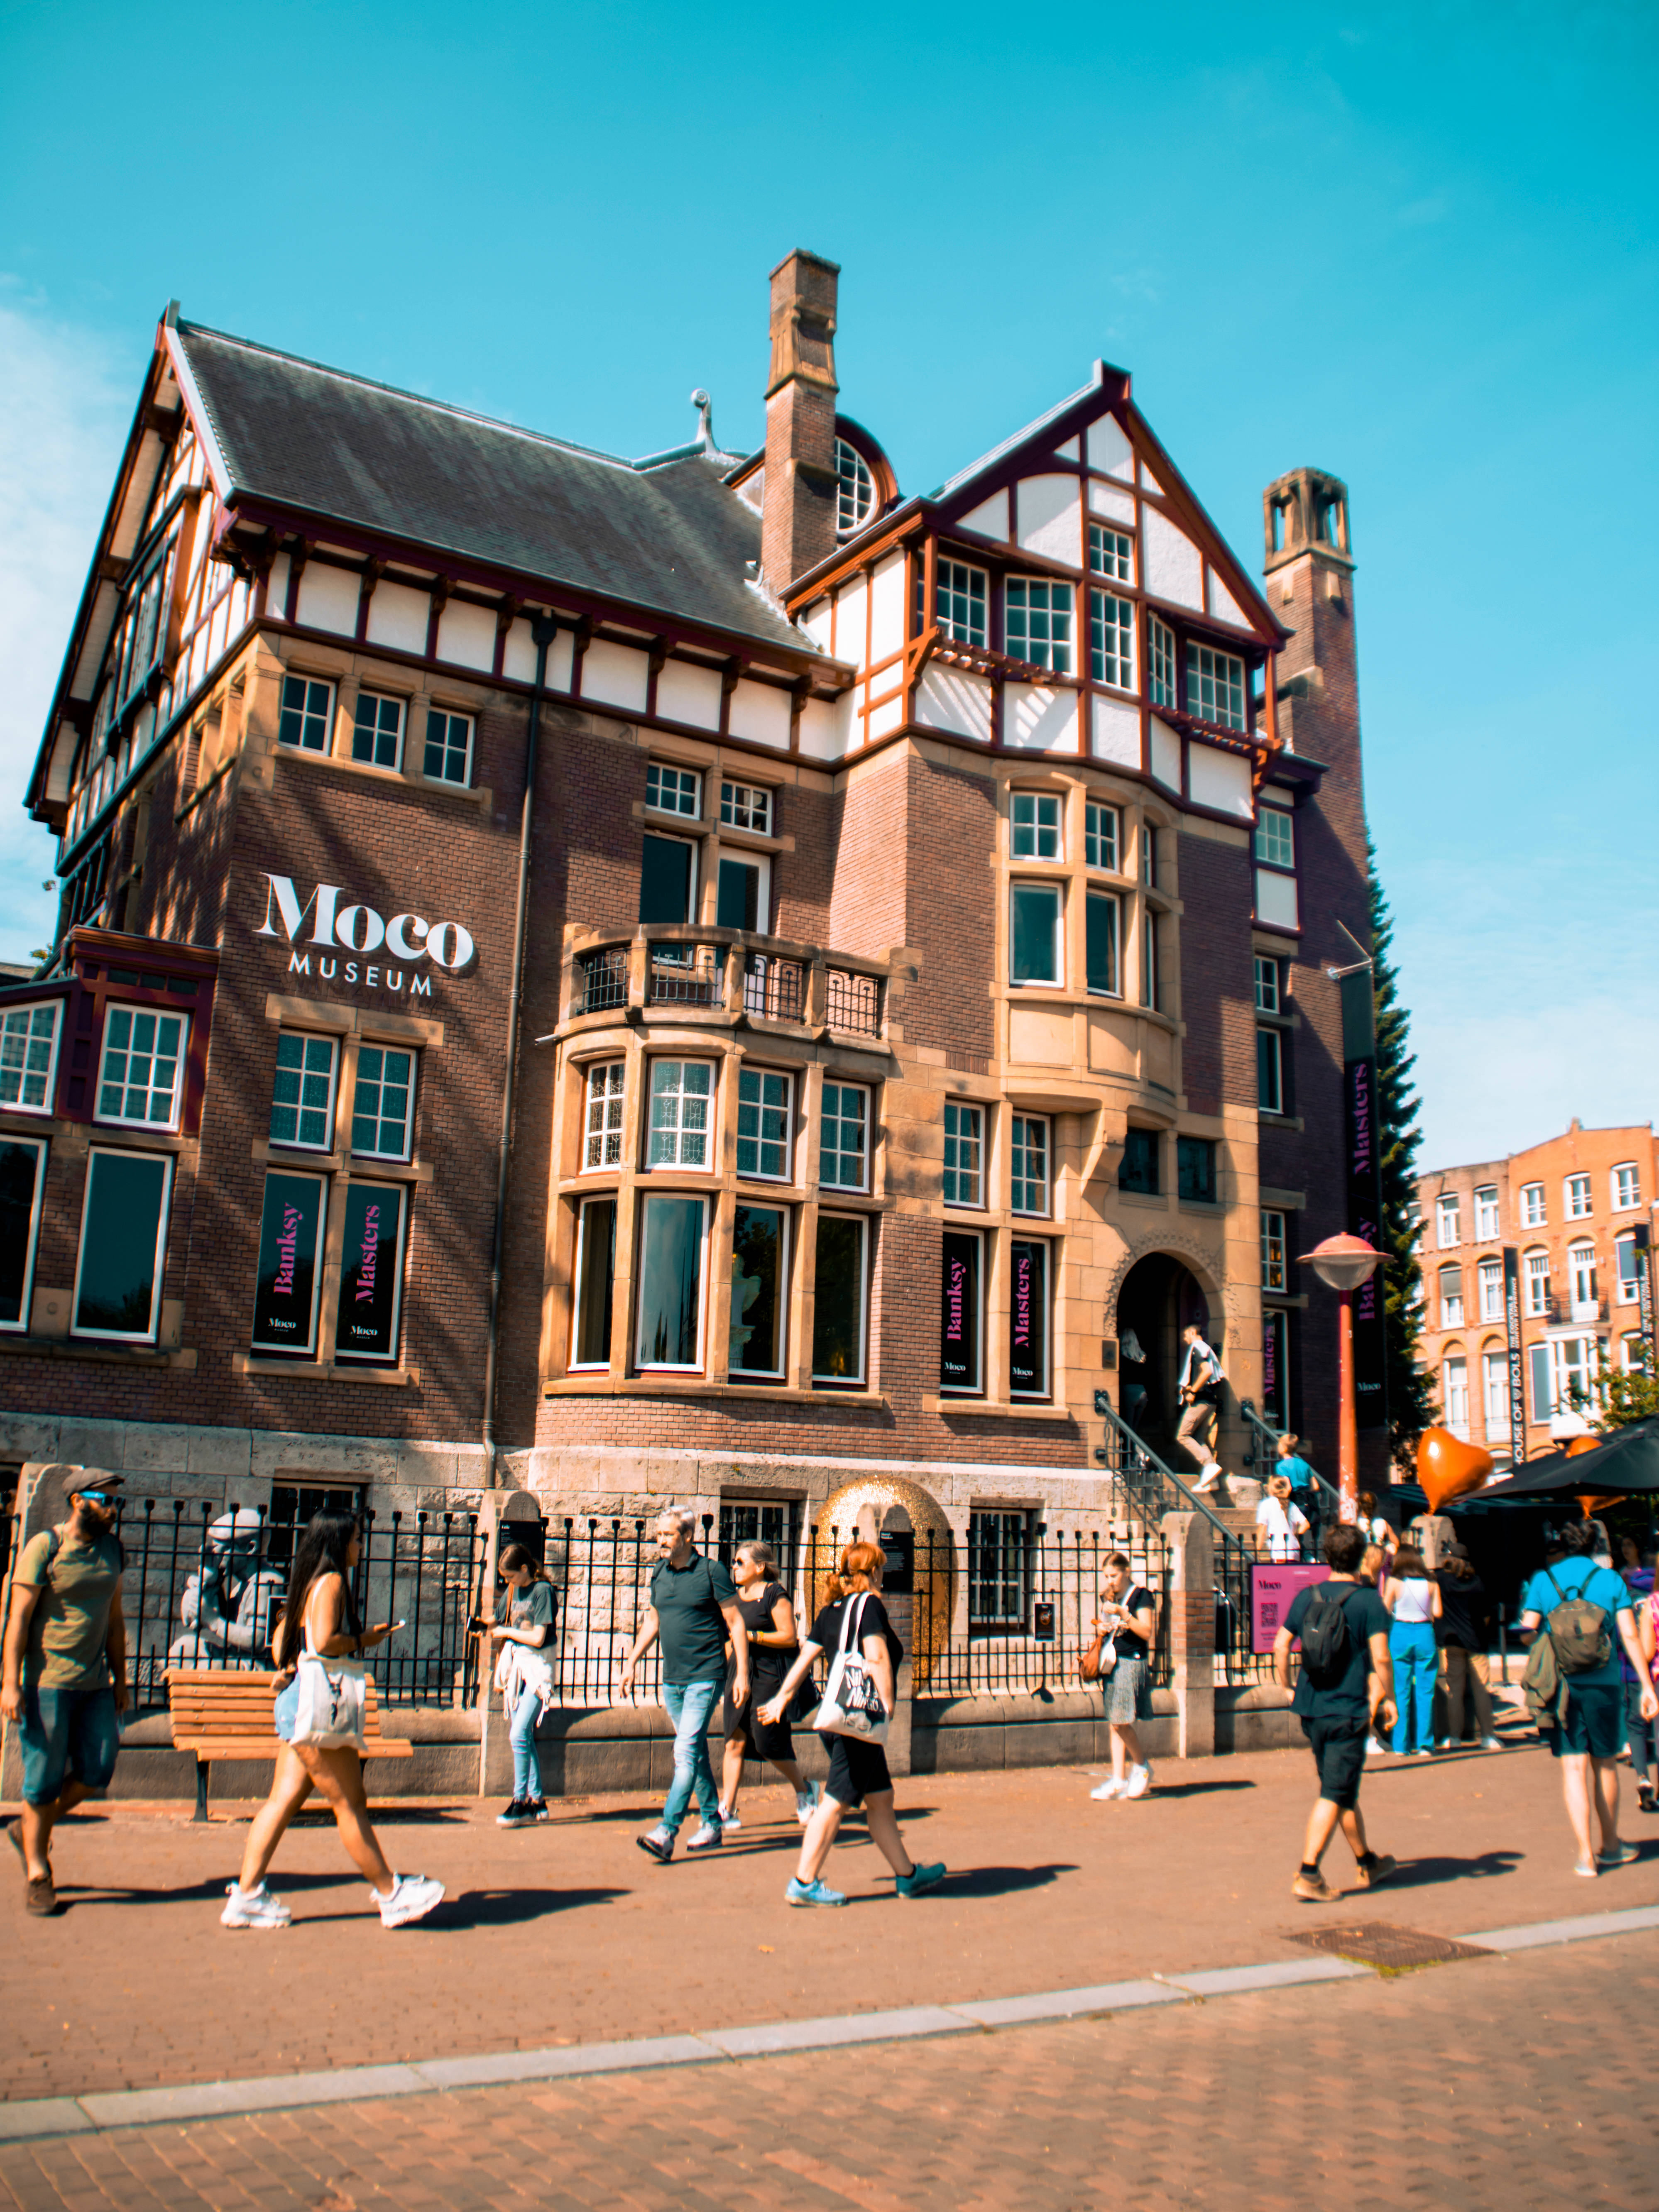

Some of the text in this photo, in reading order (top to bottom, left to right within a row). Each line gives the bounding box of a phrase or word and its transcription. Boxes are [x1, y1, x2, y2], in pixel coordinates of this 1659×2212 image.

[252, 873, 474, 968] Moco
[288, 951, 431, 996] MUSEUM
[1353, 1063, 1377, 1320] Basy Masters
[274, 1203, 303, 1295] Banksy
[355, 1205, 380, 1304] Masters
[947, 1257, 966, 1341] Banksy
[1015, 1258, 1030, 1348] Masters
[268, 1317, 296, 1329] Moco
[350, 1325, 378, 1336] Moco
[945, 1361, 966, 1371] Moco
[1012, 1367, 1033, 1376] Moco
[1265, 1326, 1275, 1395] Masters
[1510, 1353, 1522, 1387] BOLS
[1357, 1382, 1381, 1391] Moco
[1512, 1401, 1523, 1421] OF
[1258, 1579, 1282, 1590] Moco
